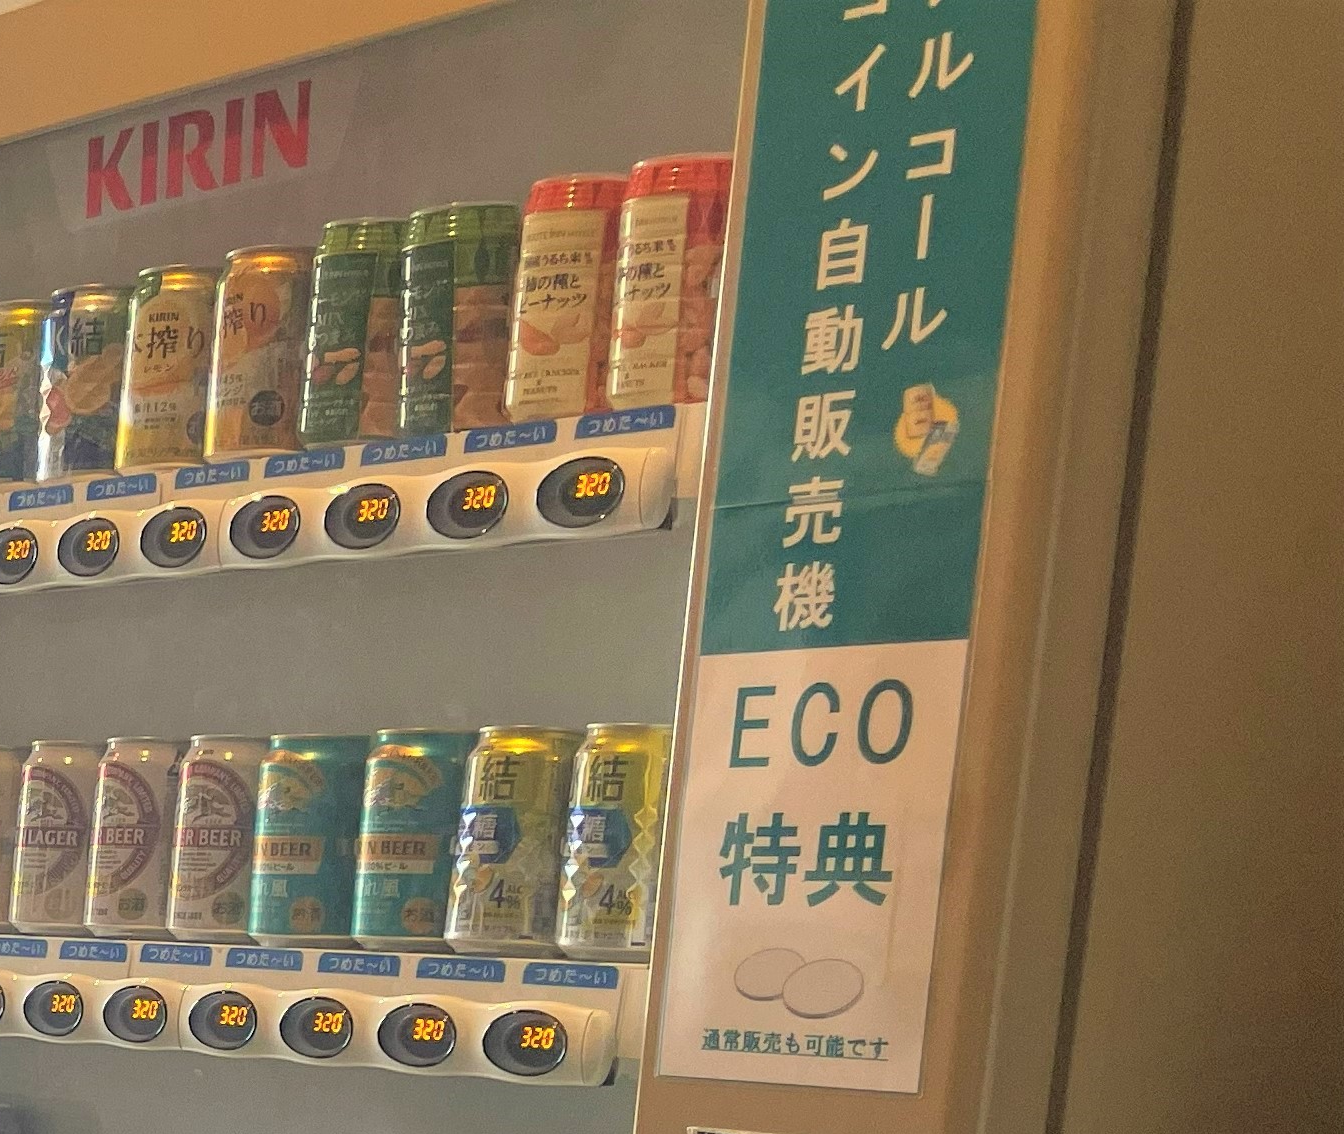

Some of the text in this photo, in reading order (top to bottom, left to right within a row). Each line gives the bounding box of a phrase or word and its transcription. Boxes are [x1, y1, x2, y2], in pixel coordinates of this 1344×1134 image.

[85, 77, 312, 219] KIRIN
[882, 0, 975, 351] ルコール
[575, 473, 610, 497] 320
[462, 486, 496, 510] 320
[357, 498, 388, 521] 320
[170, 520, 197, 542] 320
[261, 510, 289, 533] 320
[6, 539, 30, 561] 320
[86, 530, 111, 552] 320
[729, 678, 914, 769] ECO
[28, 830, 78, 846] LAGER
[106, 828, 144, 844] BEER
[199, 829, 242, 846] BEER
[719, 811, 893, 906] 特典
[51, 994, 75, 1013] 320
[131, 1000, 159, 1020] 320
[219, 1005, 247, 1025] 320
[313, 1012, 342, 1033] 320
[413, 1019, 444, 1041] 320
[521, 1027, 554, 1049] 320
[701, 1028, 889, 1059] 通常販売も可能です
